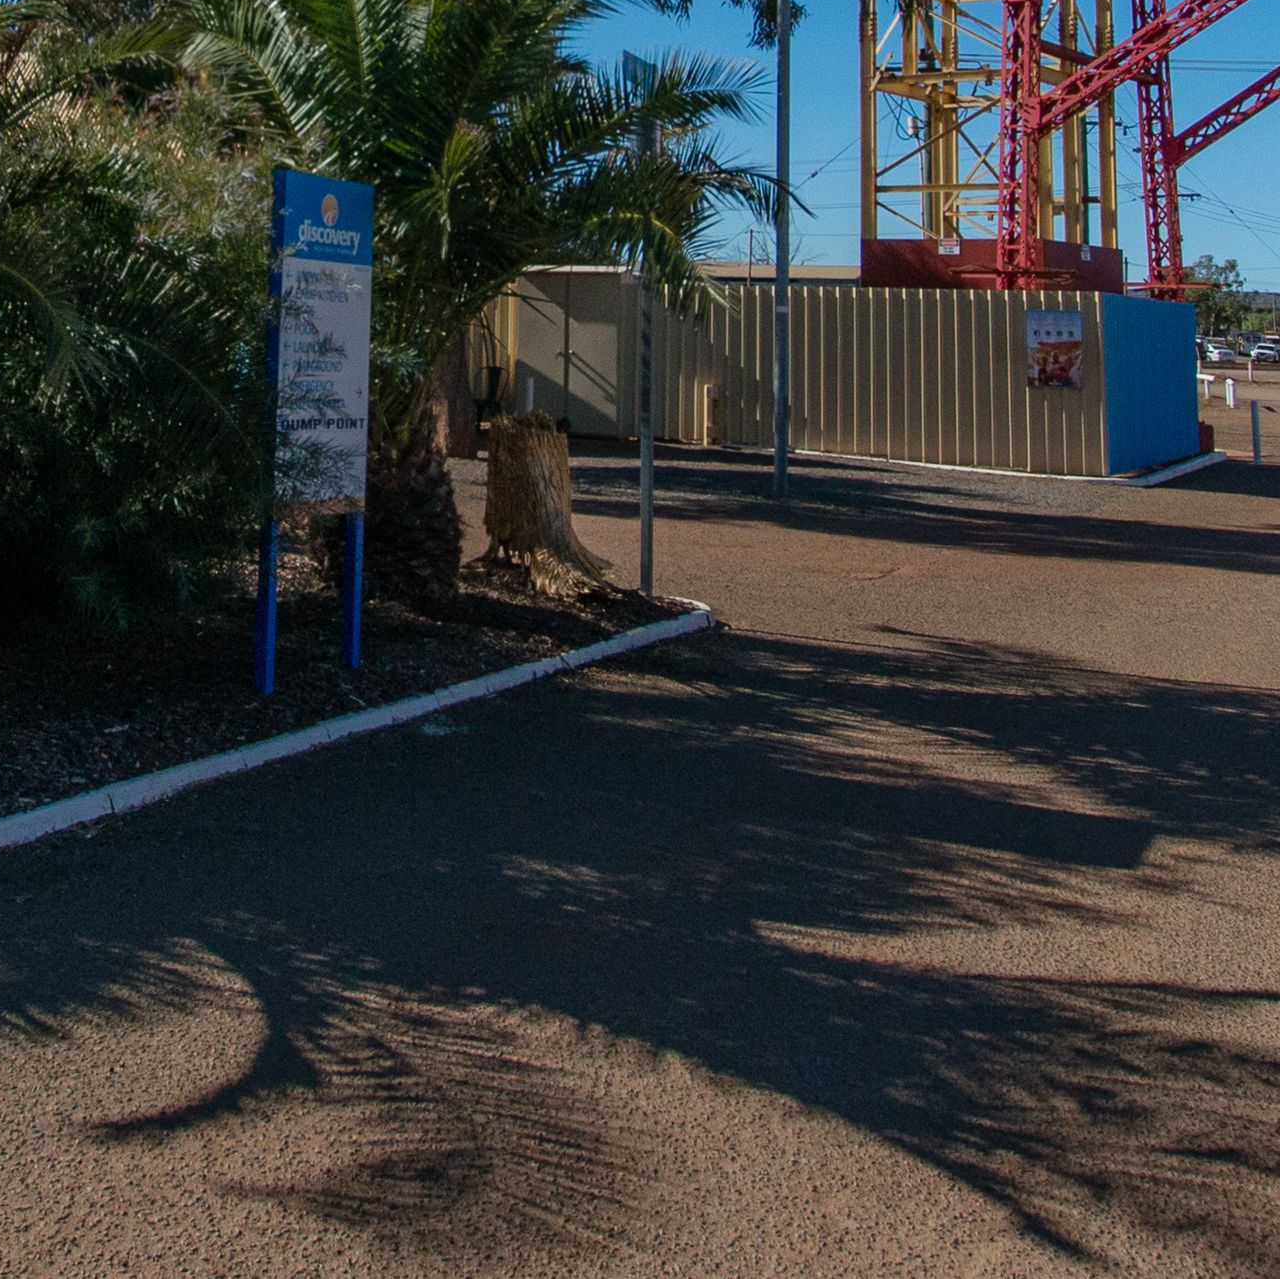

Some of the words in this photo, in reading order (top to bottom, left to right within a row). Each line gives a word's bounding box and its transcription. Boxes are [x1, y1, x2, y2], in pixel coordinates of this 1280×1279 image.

[298, 219, 361, 256] discovery
[280, 417, 322, 431] DUMP
[326, 417, 366, 430] POINT
